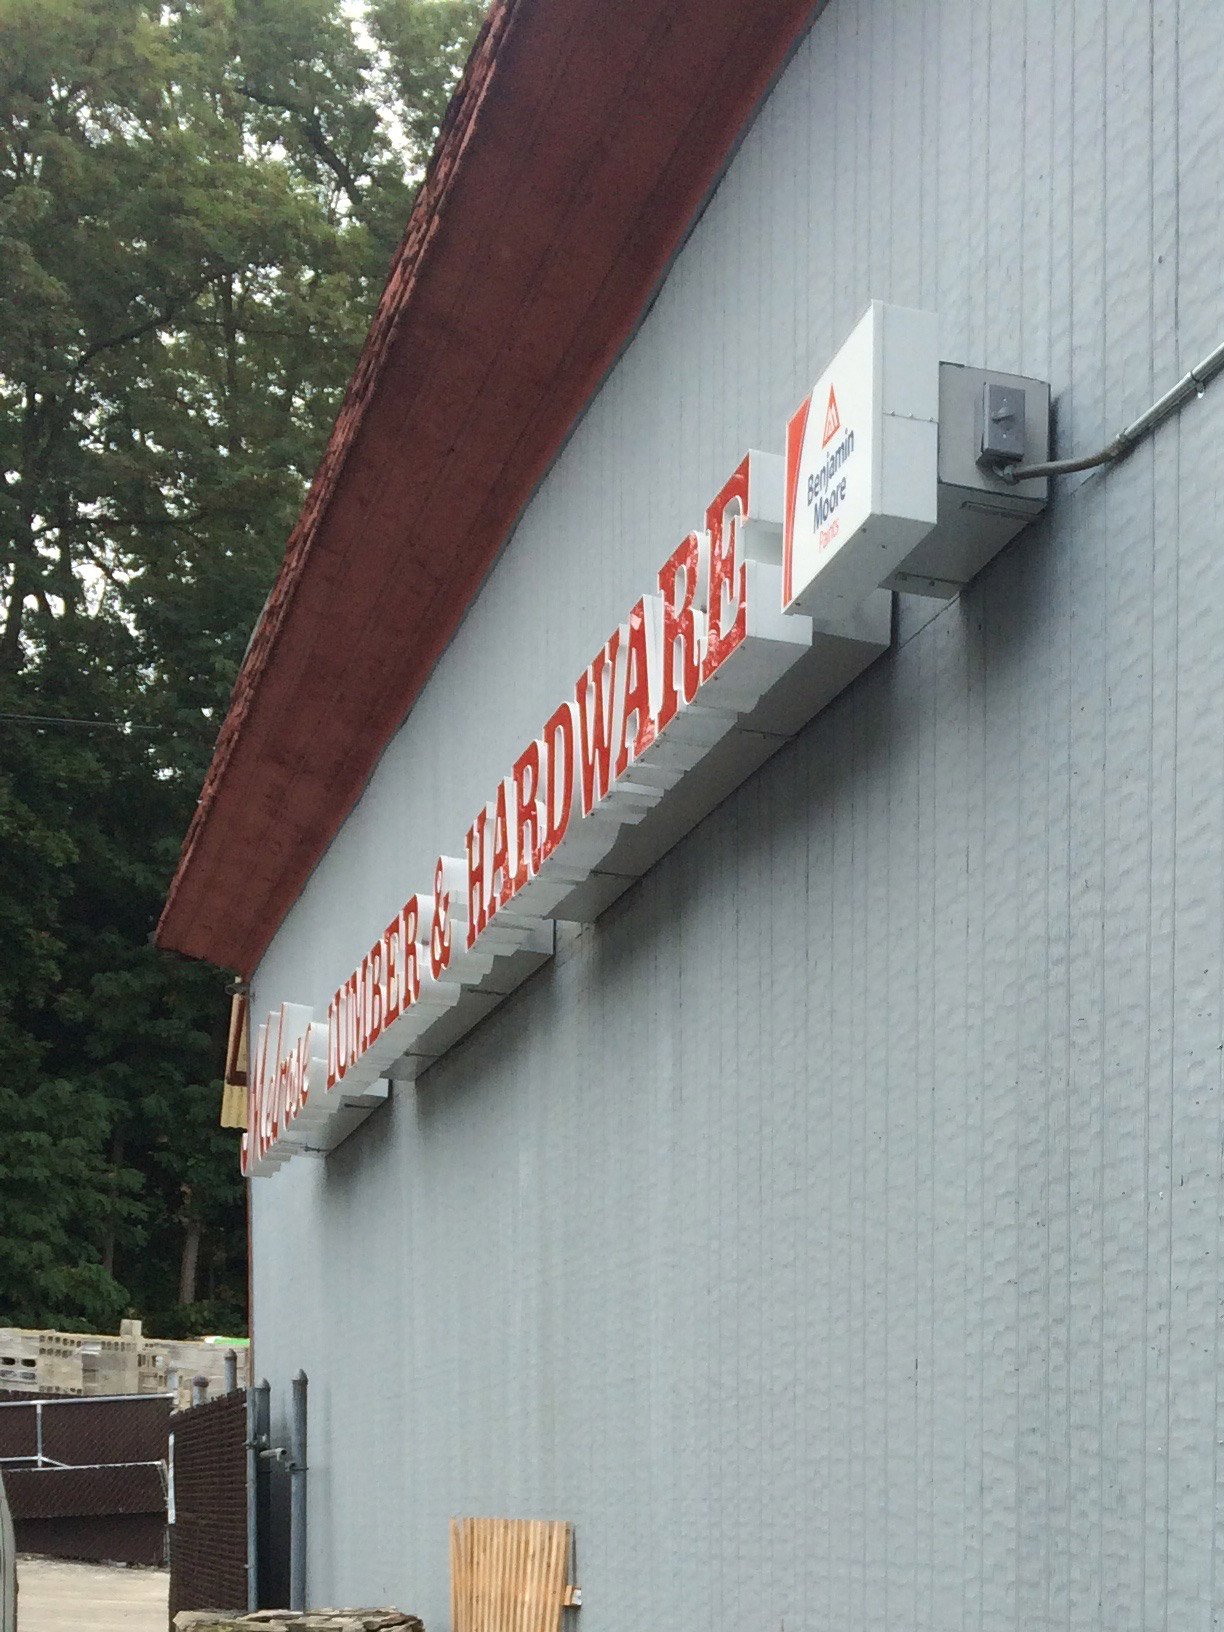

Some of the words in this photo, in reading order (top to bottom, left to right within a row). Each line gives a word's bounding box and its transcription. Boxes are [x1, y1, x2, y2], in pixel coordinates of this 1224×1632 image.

[808, 428, 855, 506] Benjamin
[813, 476, 847, 533] Moore
[327, 894, 420, 1091] LUMBER
[431, 856, 450, 981] &
[466, 451, 749, 953] HARDWARE
